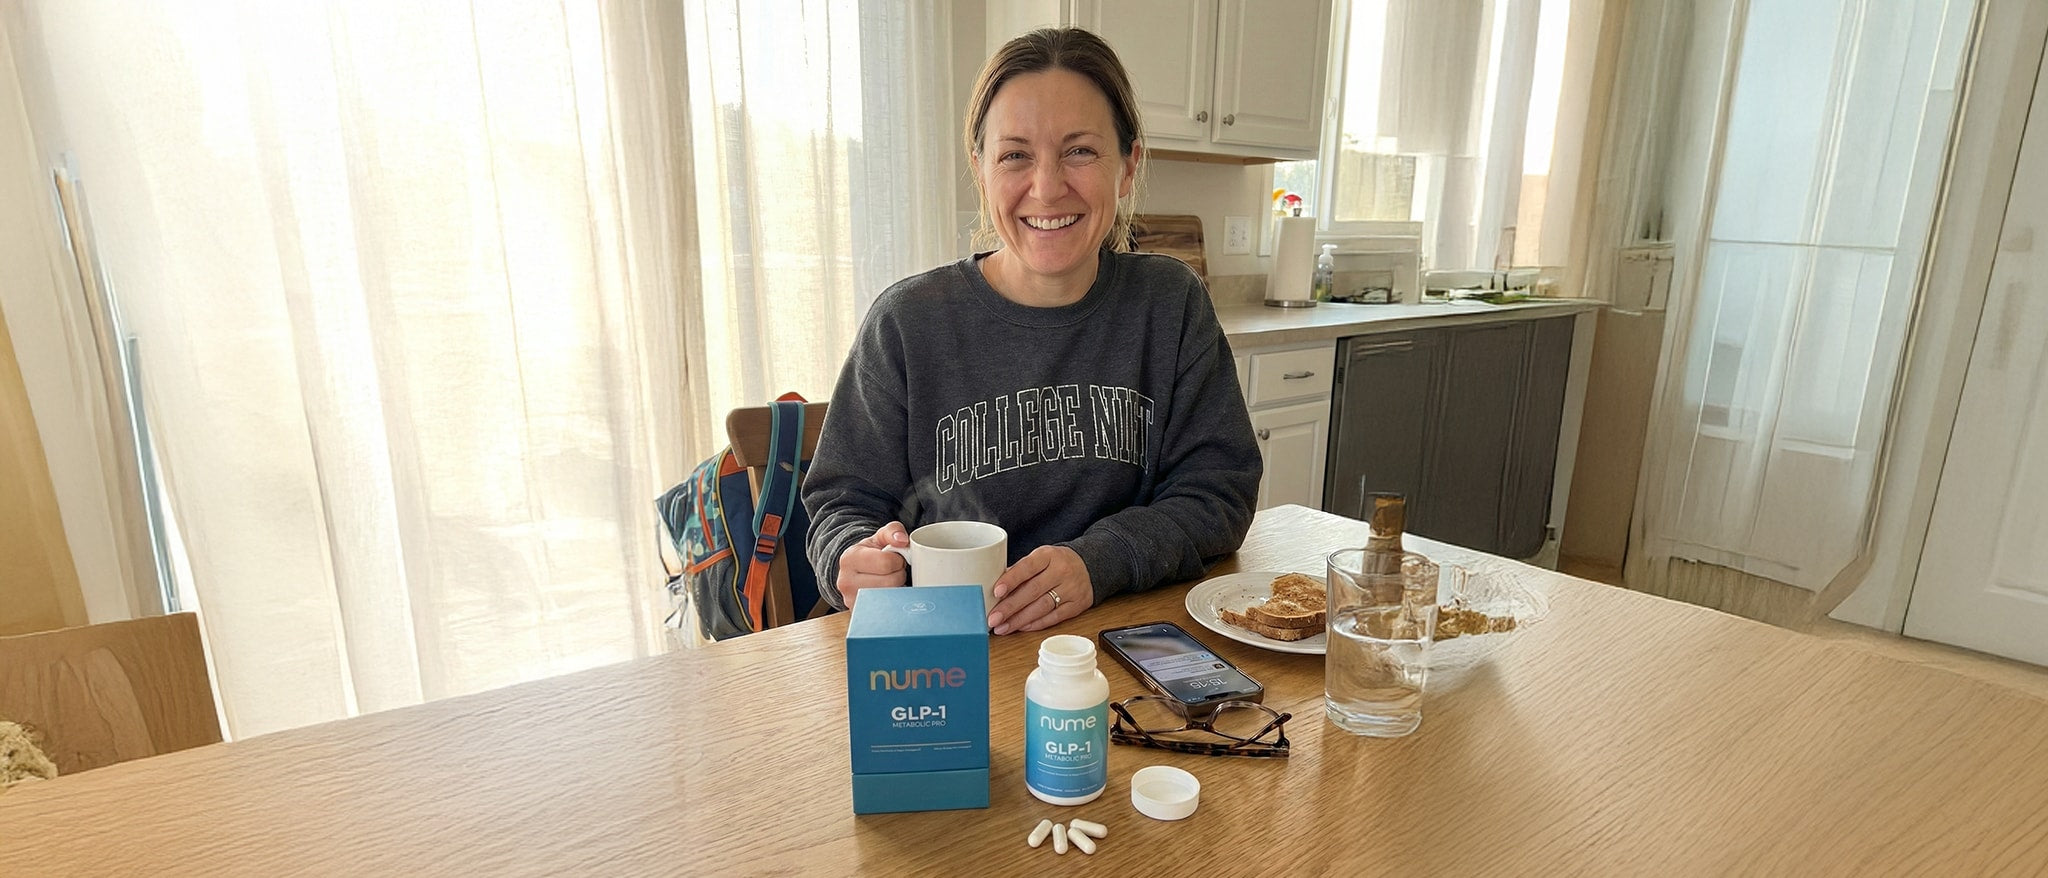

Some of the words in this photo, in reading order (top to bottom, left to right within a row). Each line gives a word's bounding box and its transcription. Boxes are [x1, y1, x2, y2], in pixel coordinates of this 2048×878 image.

[936, 384, 1085, 494] COLLEGE
[869, 666, 967, 691] nume
[891, 705, 946, 721] GLP-1
[892, 721, 931, 729] METABOLIC
[931, 720, 947, 728] PRO
[1040, 715, 1097, 732] nume
[1045, 740, 1091, 756] GLP-1
[1044, 753, 1080, 762] METABOLIC
[1080, 752, 1093, 761] PRO
